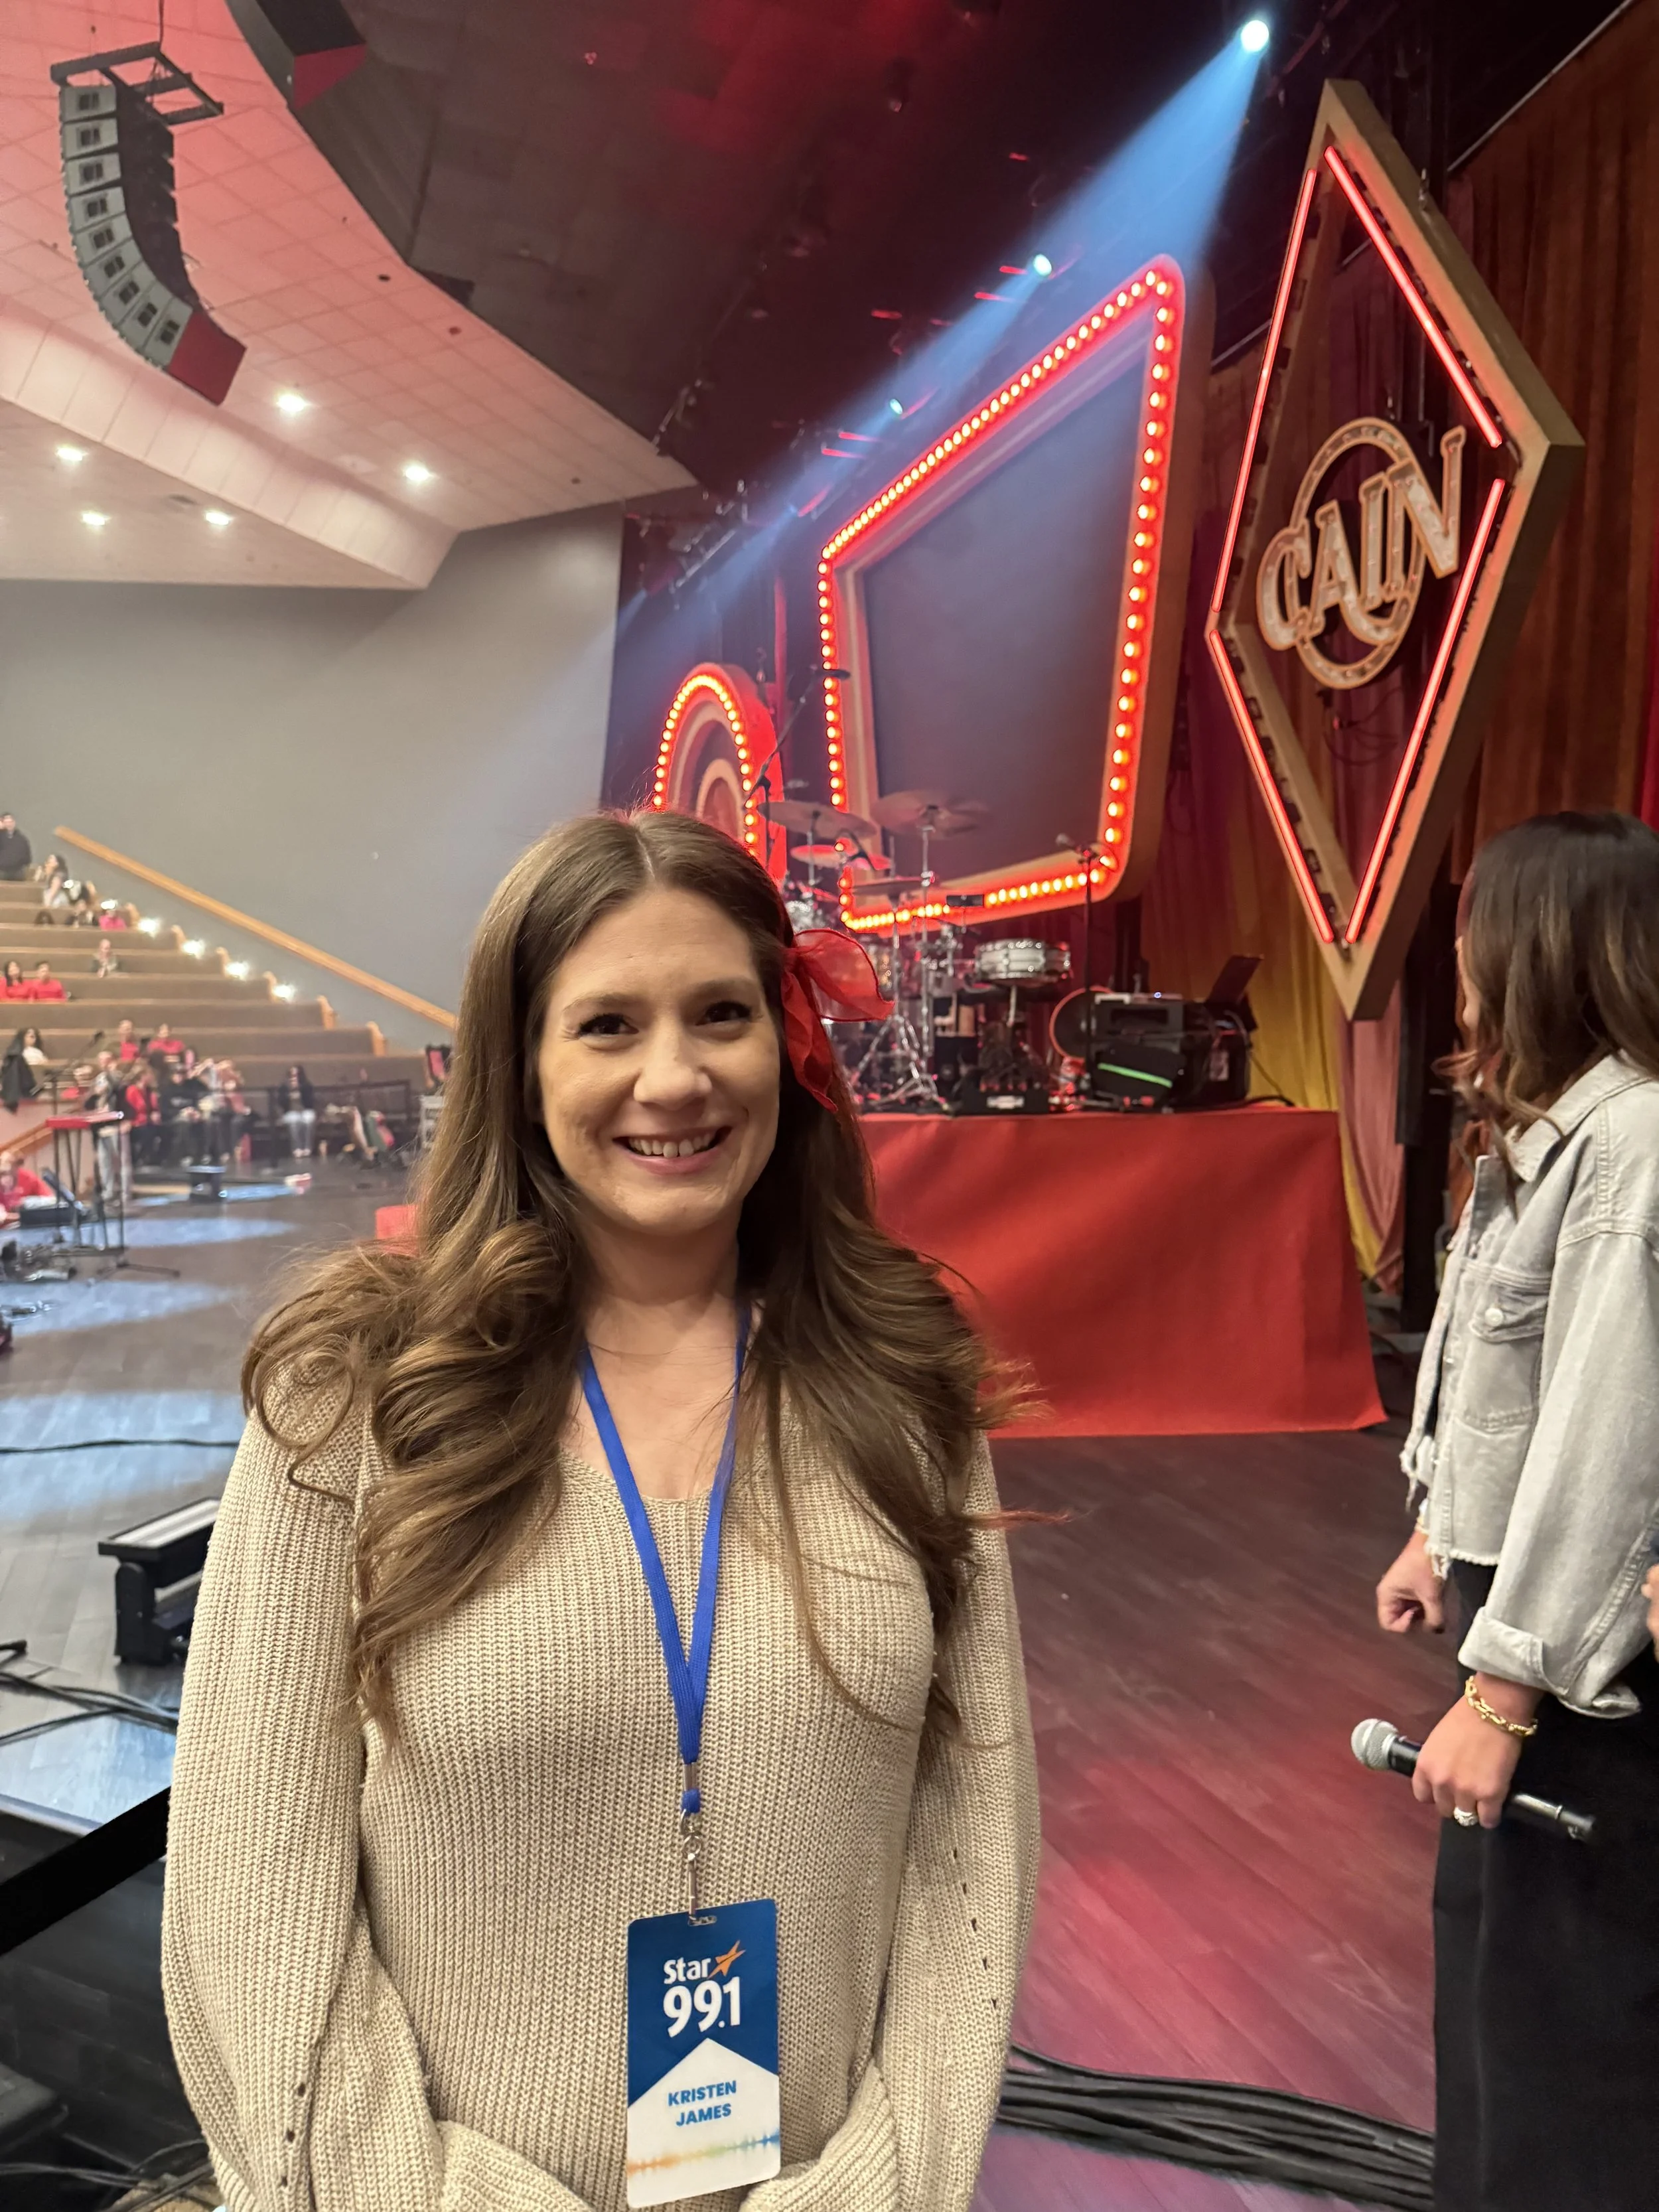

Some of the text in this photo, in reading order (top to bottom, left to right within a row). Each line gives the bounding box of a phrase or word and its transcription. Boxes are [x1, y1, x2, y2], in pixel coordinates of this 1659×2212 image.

[1256, 425, 1467, 651] CAIN
[664, 1958, 711, 1984] Star
[664, 1976, 741, 2037] 99.1
[668, 2080, 737, 2106] KRISTEN
[676, 2102, 731, 2126] JAMES
